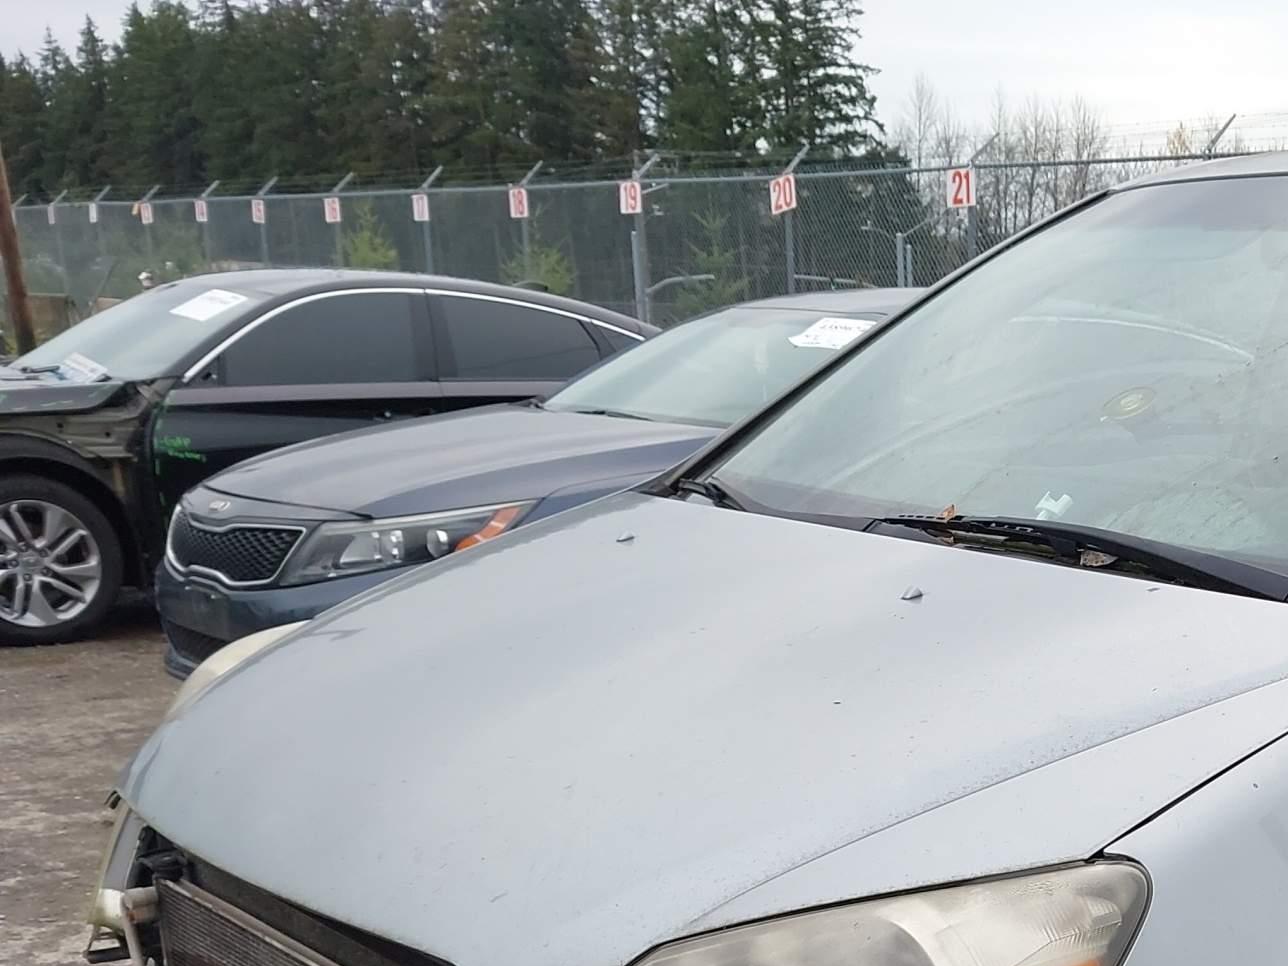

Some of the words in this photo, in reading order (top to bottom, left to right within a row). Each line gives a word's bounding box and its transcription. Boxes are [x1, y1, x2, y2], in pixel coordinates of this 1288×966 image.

[624, 183, 637, 211] 19
[772, 176, 793, 211] 20
[951, 169, 971, 205] 21
